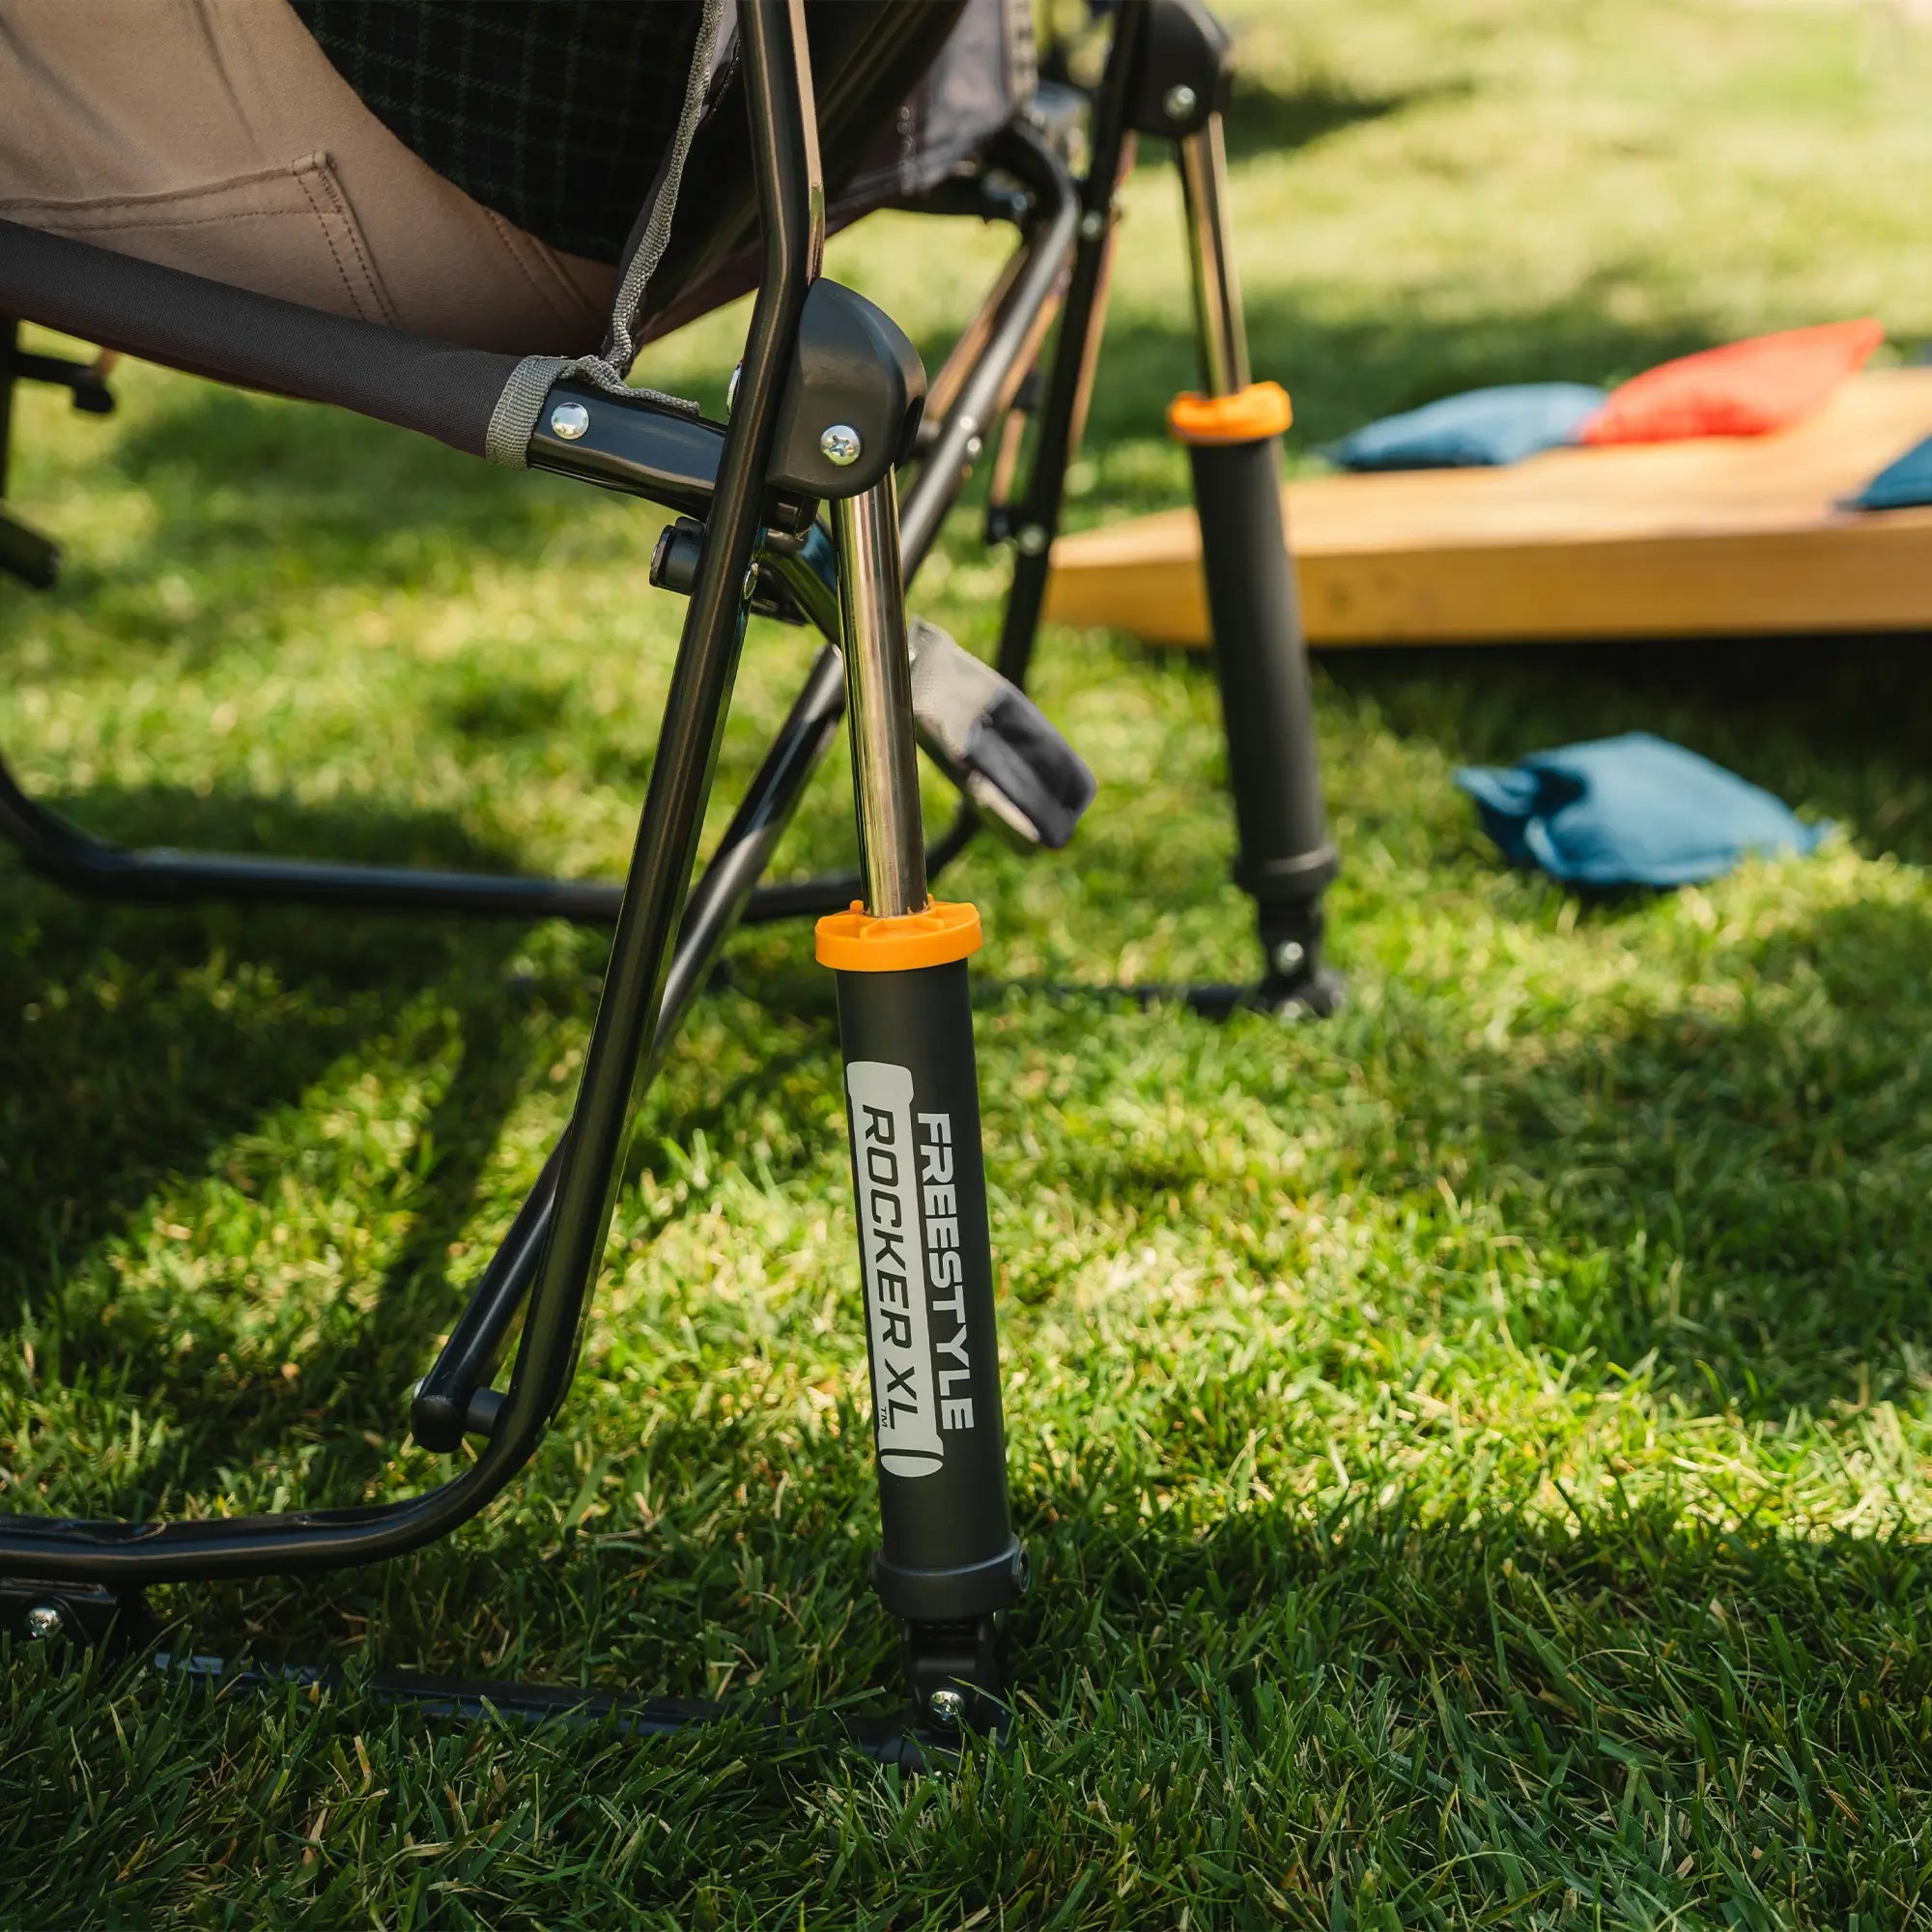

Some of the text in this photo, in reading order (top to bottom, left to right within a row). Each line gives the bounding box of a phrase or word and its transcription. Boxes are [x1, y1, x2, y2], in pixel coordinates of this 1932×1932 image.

[863, 1104, 918, 1430] ROCKER XL
[918, 1113, 974, 1430] FREESTYLE
